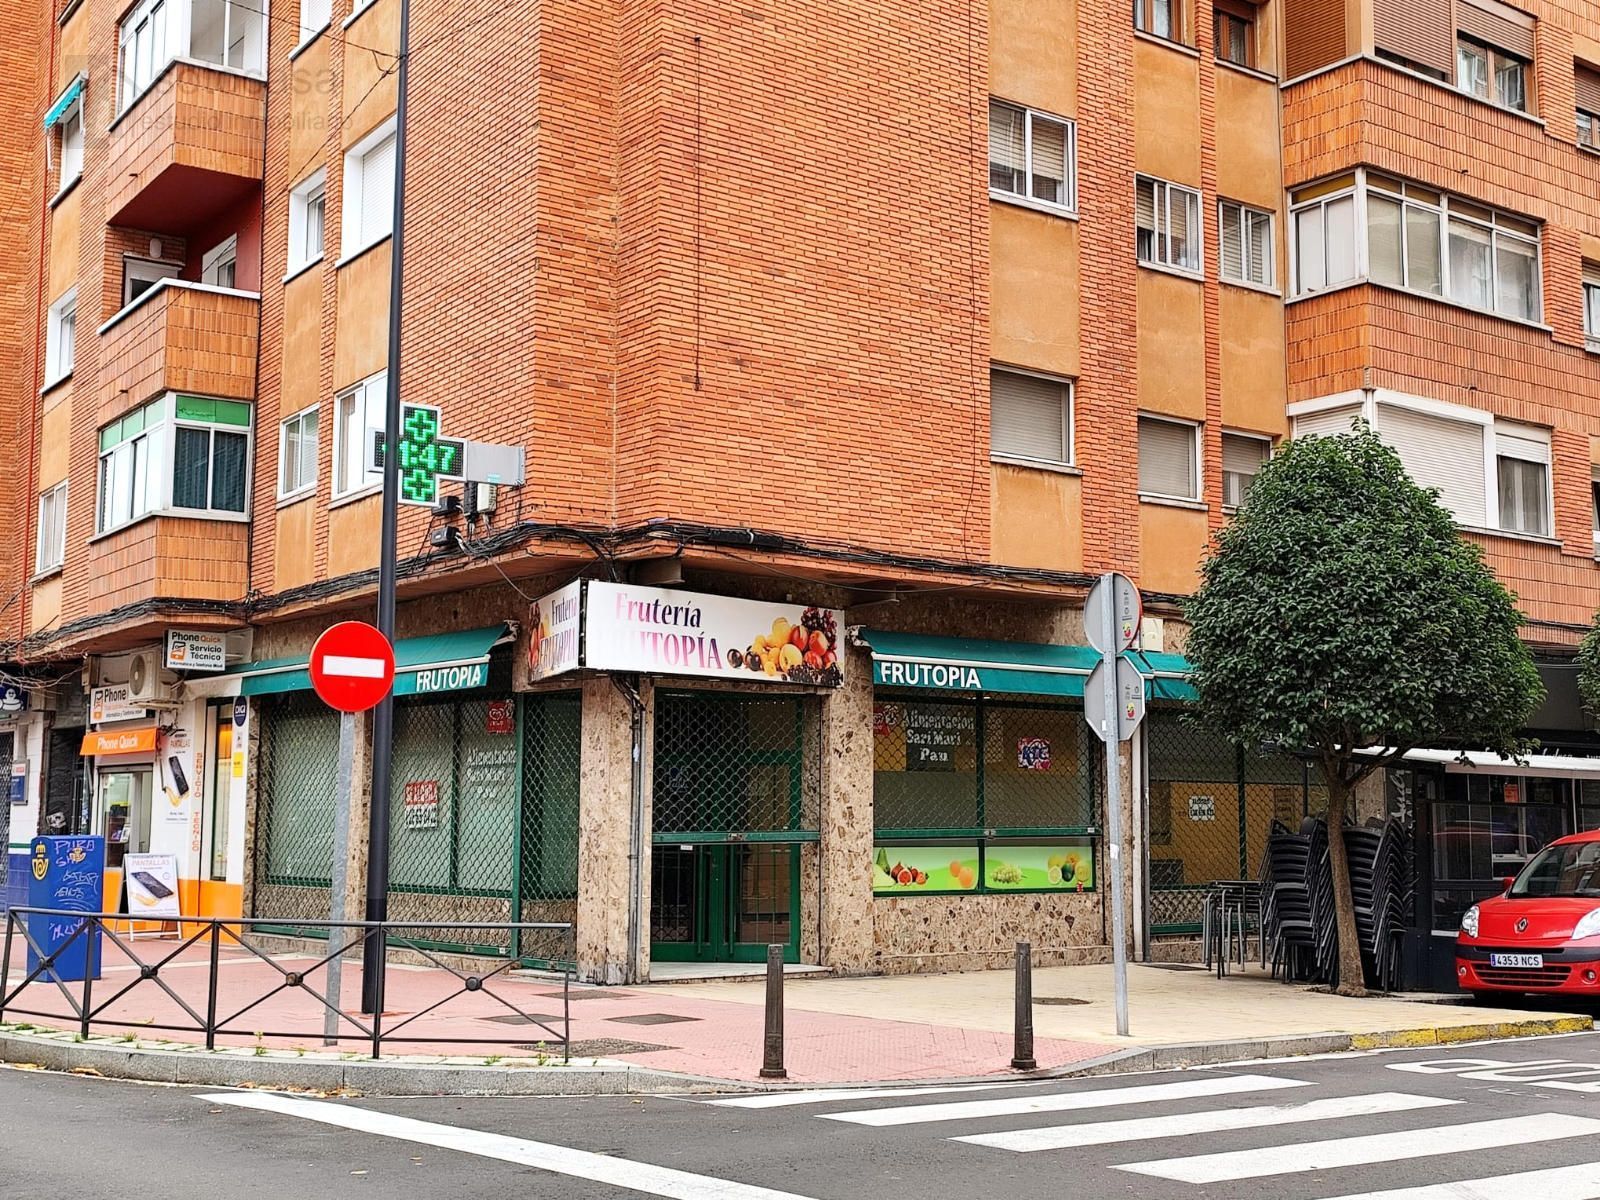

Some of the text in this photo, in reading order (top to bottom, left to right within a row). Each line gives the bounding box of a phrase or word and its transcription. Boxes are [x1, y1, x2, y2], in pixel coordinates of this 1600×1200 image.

[381, 440, 455, 472] 1:47
[615, 591, 702, 628] Frutería
[172, 632, 199, 641] Phone
[190, 644, 222, 653] Servicio
[191, 652, 221, 661] Técnico
[416, 664, 481, 692] FRUTOPIA
[880, 662, 982, 689] FRUTOPIA
[105, 688, 127, 702] Phone
[235, 705, 246, 714] DIGI
[98, 734, 138, 750] Phone Quick
[194, 753, 202, 798] SERVICIO
[131, 859, 171, 867] PANTALLAS
[1497, 955, 1540, 966] 4353 NCS
